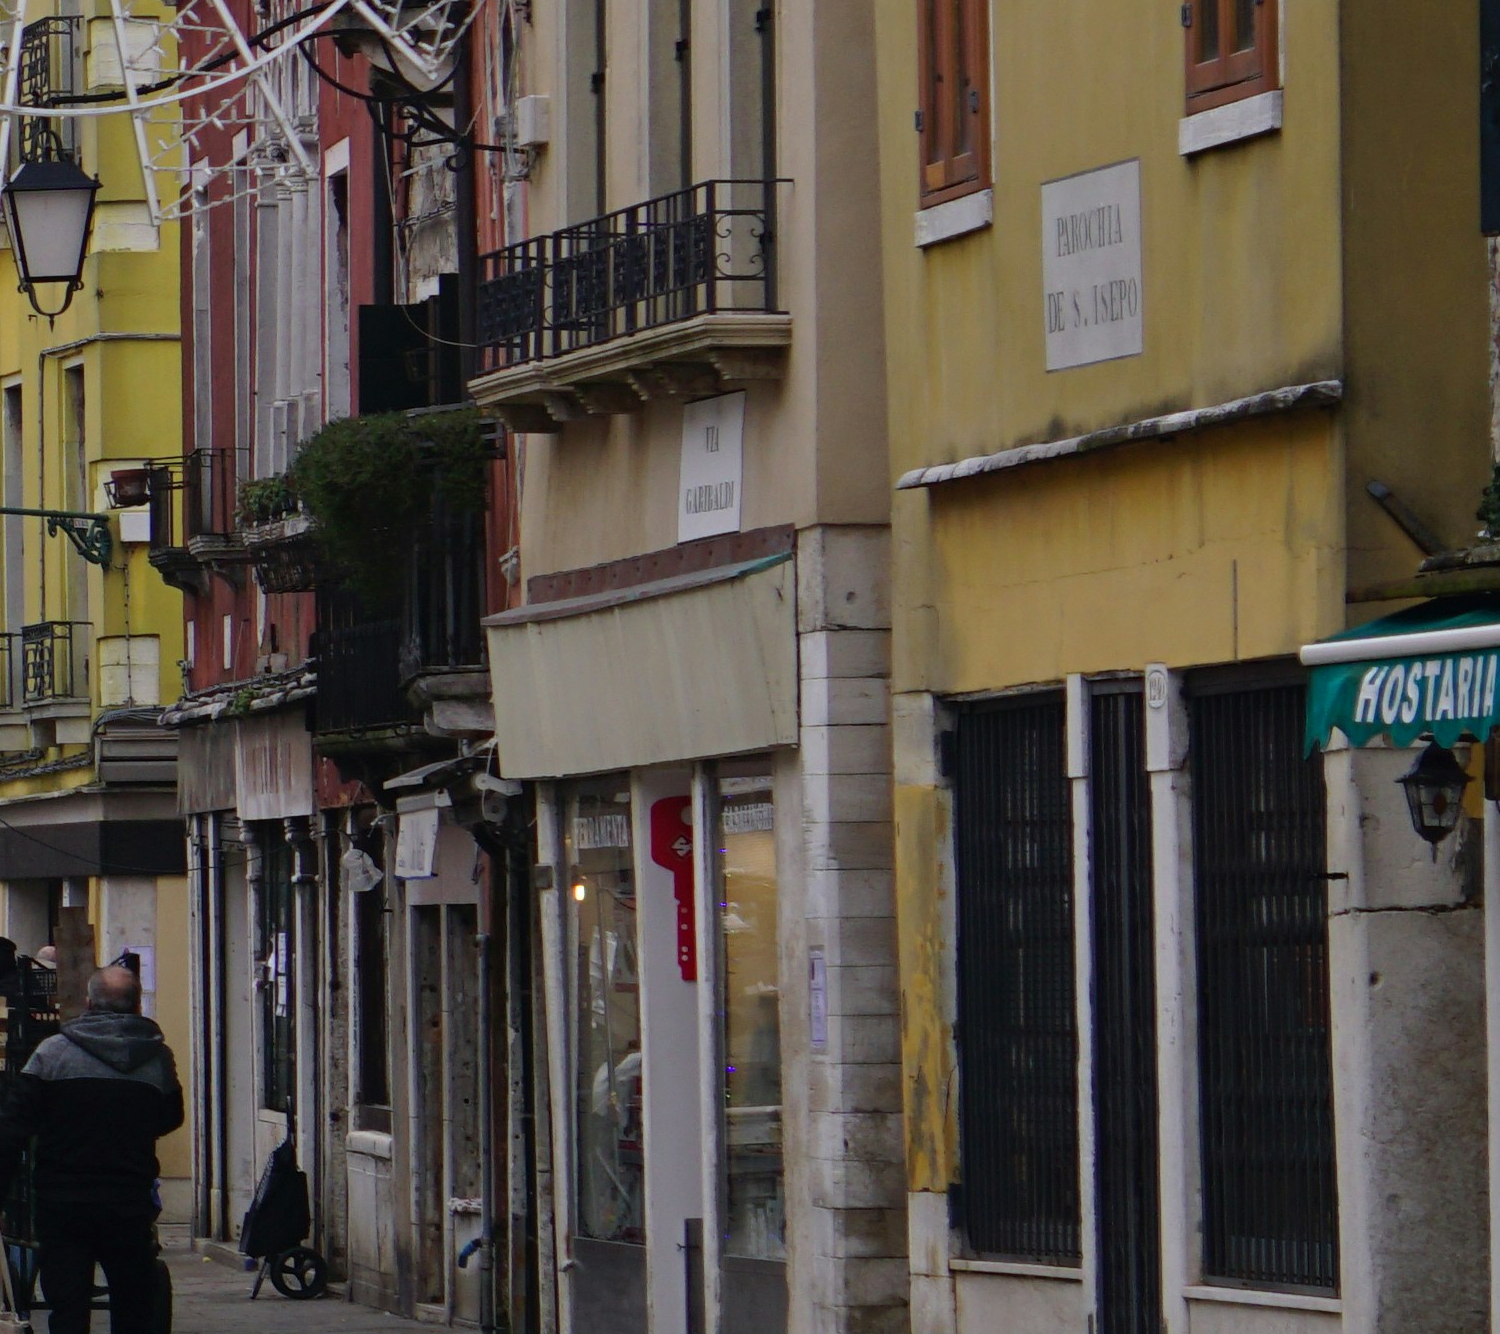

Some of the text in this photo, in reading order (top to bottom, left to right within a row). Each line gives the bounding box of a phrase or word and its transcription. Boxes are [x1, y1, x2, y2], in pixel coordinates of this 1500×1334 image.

[1056, 203, 1123, 258] PAROCHIA
[1047, 291, 1066, 335] DE
[1354, 654, 1498, 725] HOSTARIA
